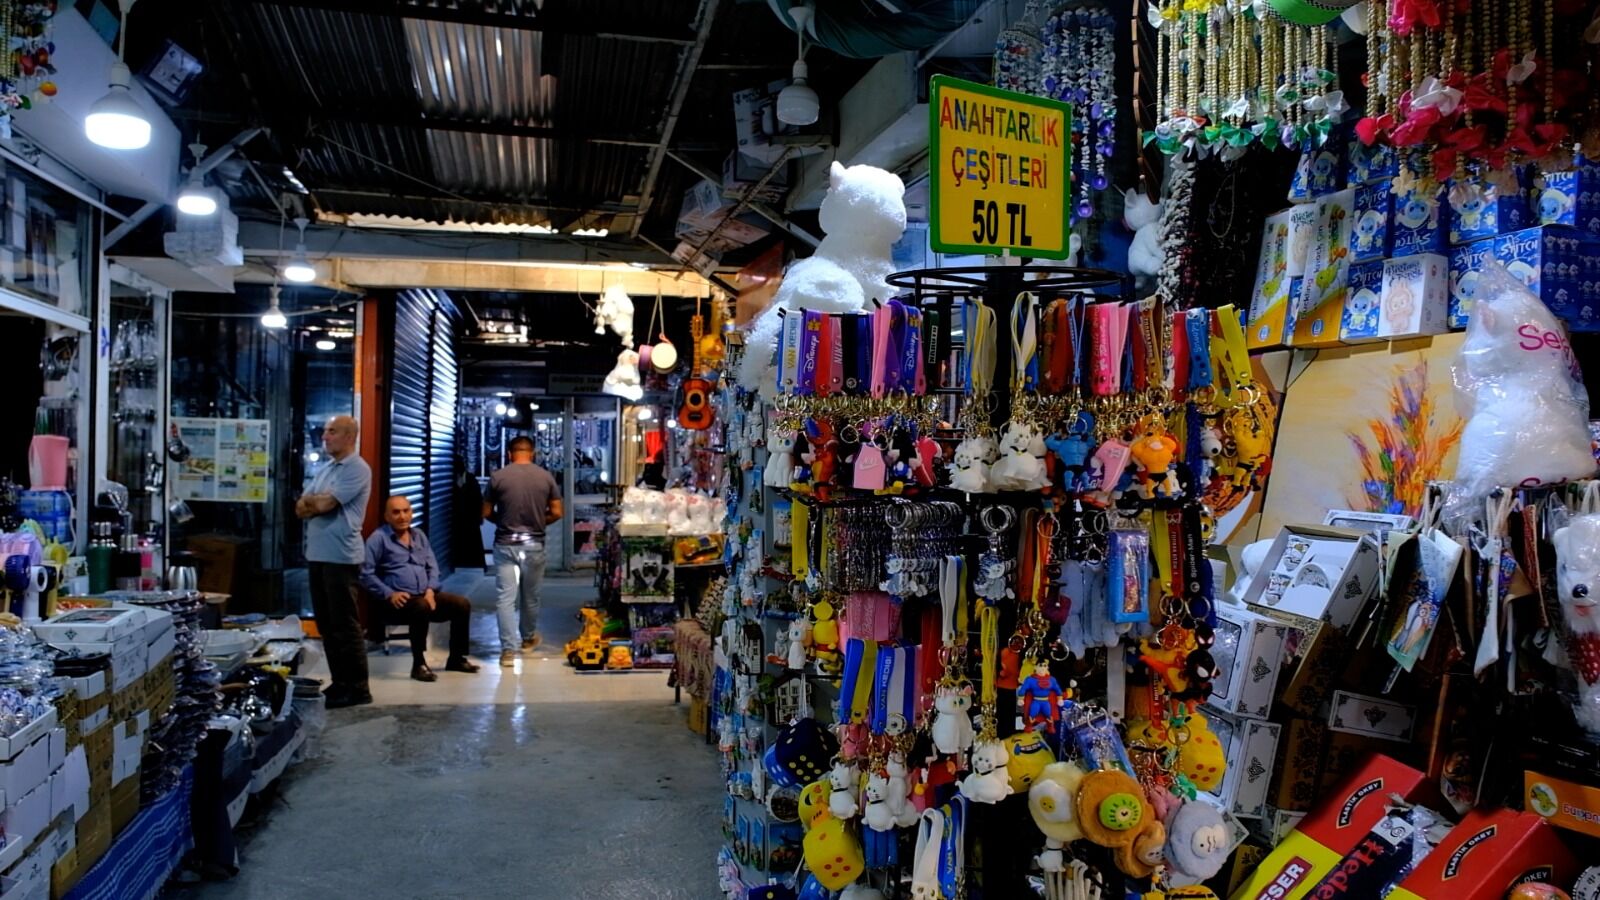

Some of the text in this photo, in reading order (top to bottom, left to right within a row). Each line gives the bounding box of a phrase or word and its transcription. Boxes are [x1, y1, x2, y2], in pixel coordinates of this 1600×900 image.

[940, 96, 1058, 147] ANAHTARLIK
[952, 146, 1047, 189] ÇEŞİTLERİ
[972, 199, 1032, 246] 50 TL
[803, 335, 820, 372] Disney
[905, 332, 919, 371] Disney
[1187, 533, 1198, 578] Spider-Man
[1357, 782, 1379, 796] OKEY
[1468, 829, 1492, 846] OKEY
[1306, 839, 1384, 900] Hede
